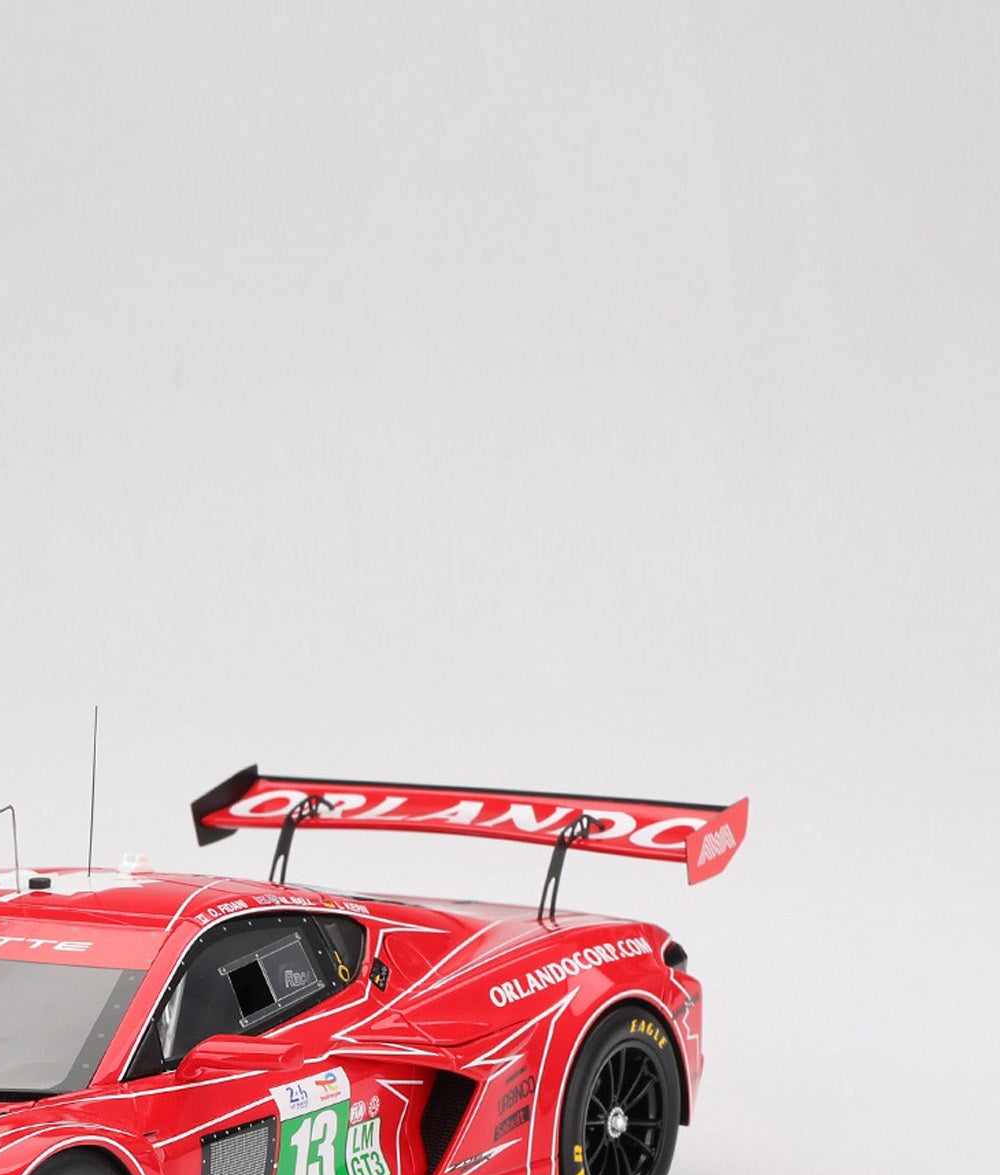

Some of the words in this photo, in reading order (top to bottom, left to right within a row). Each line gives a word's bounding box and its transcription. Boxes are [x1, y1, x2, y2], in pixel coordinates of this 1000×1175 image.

[228, 789, 708, 849] ORLANDO
[489, 937, 653, 1008] ORLANDOCORP.COM
[629, 1018, 669, 1049] EAGLE
[352, 1121, 374, 1153] LM
